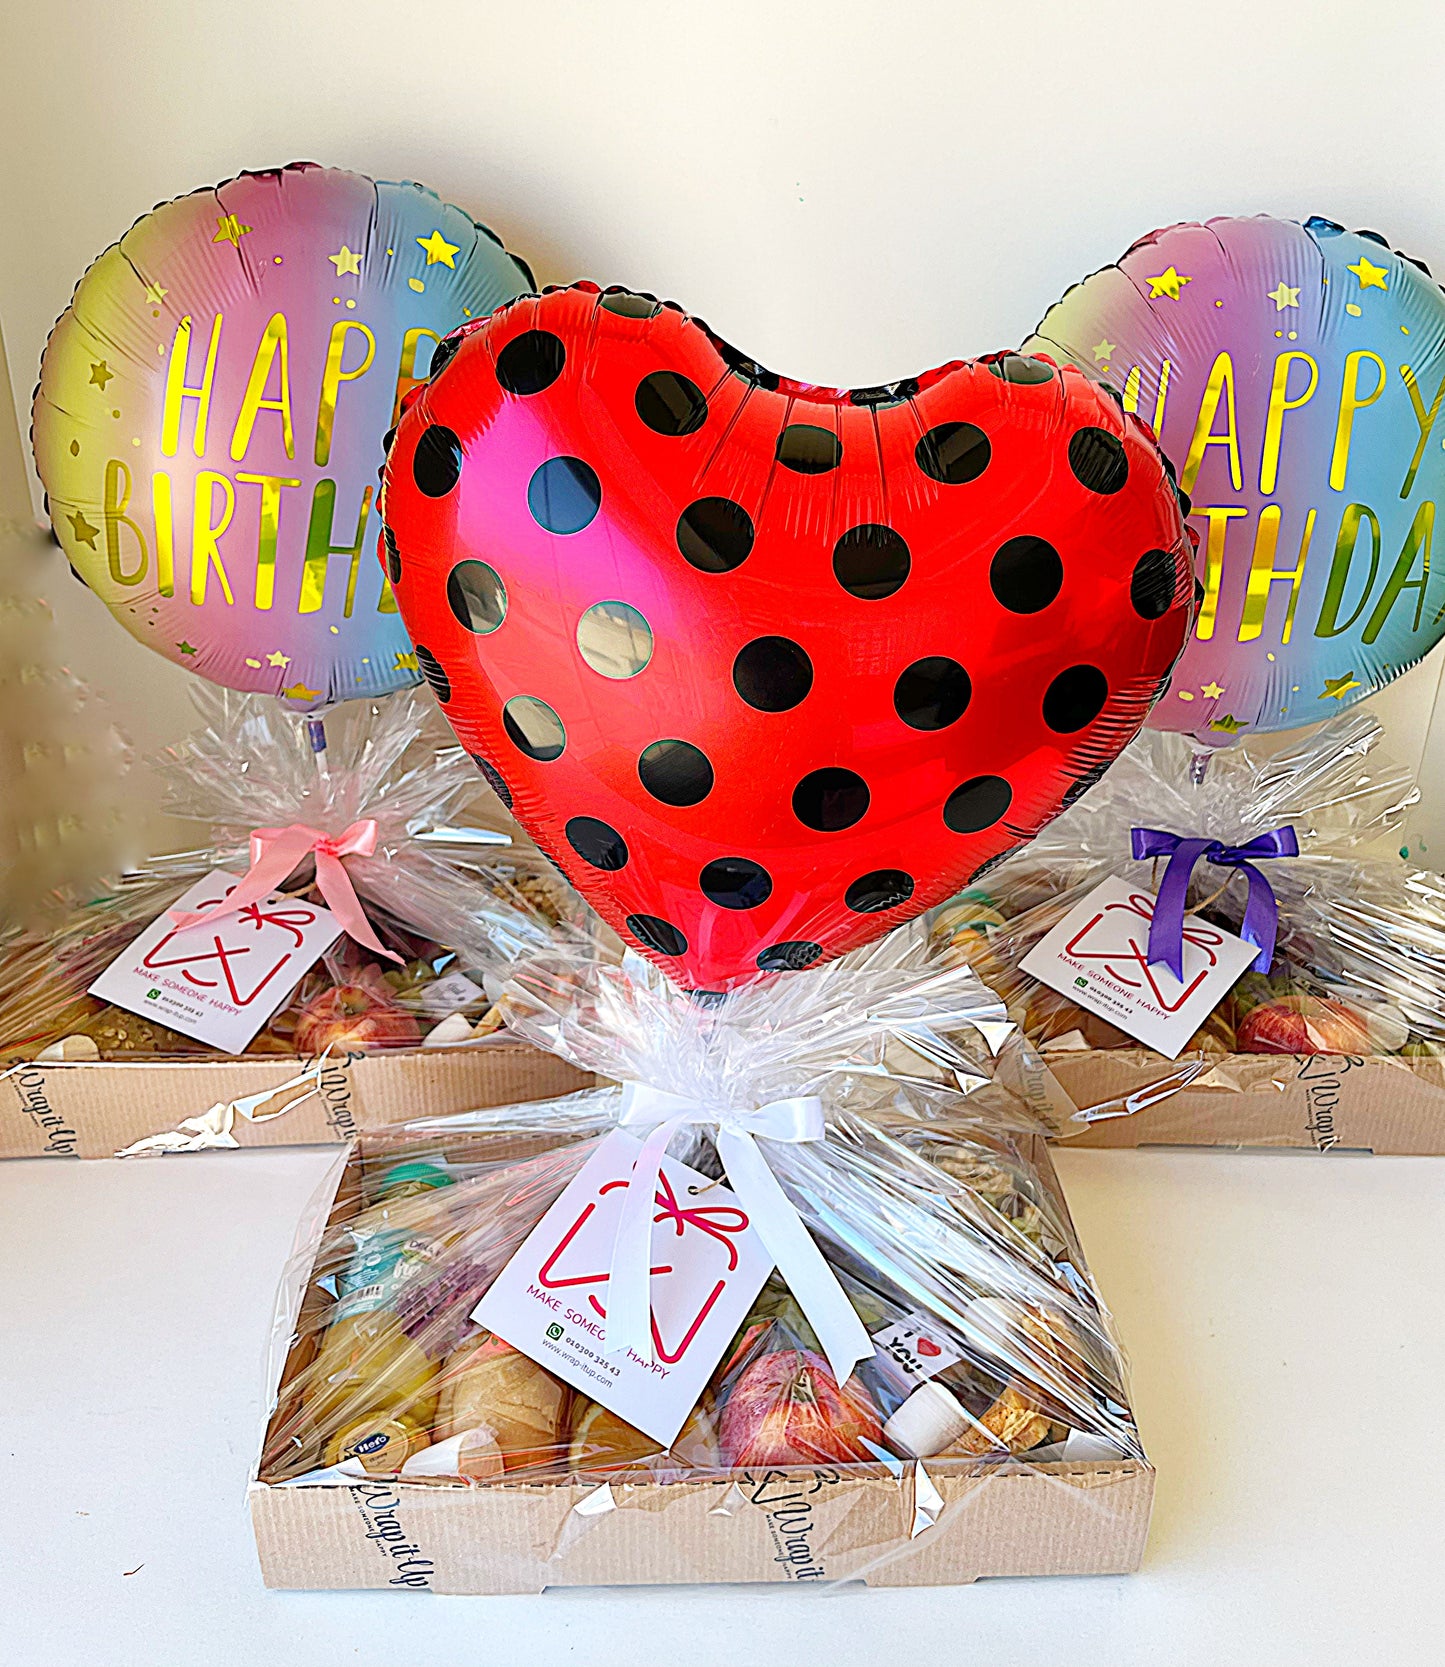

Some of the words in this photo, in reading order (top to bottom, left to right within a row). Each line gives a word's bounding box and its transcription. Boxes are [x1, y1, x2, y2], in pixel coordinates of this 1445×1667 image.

[161, 312, 442, 468] HAPP
[105, 459, 396, 618] BIRTH
[1190, 501, 1445, 646] THDA
[133, 966, 161, 982] MAKE
[162, 978, 208, 1002] SOMEONE
[208, 997, 242, 1016] HAPPY
[1057, 952, 1086, 972] MAKE
[1087, 969, 1135, 1001] SOMEONE
[1136, 998, 1171, 1021] HAPPY
[1305, 1079, 1341, 1133] Wrap
[526, 1284, 563, 1312] MAKE
[564, 1308, 606, 1341] SOMEO
[542, 1338, 613, 1389] www.wrap-itup.com
[566, 1337, 594, 1359] 010300
[593, 1355, 609, 1370] 325
[609, 1366, 621, 1377] 43
[886, 1336, 923, 1373] YOU
[358, 1436, 387, 1453] Hero
[356, 1475, 406, 1541] Wrap
[773, 1502, 813, 1564] Wrap
